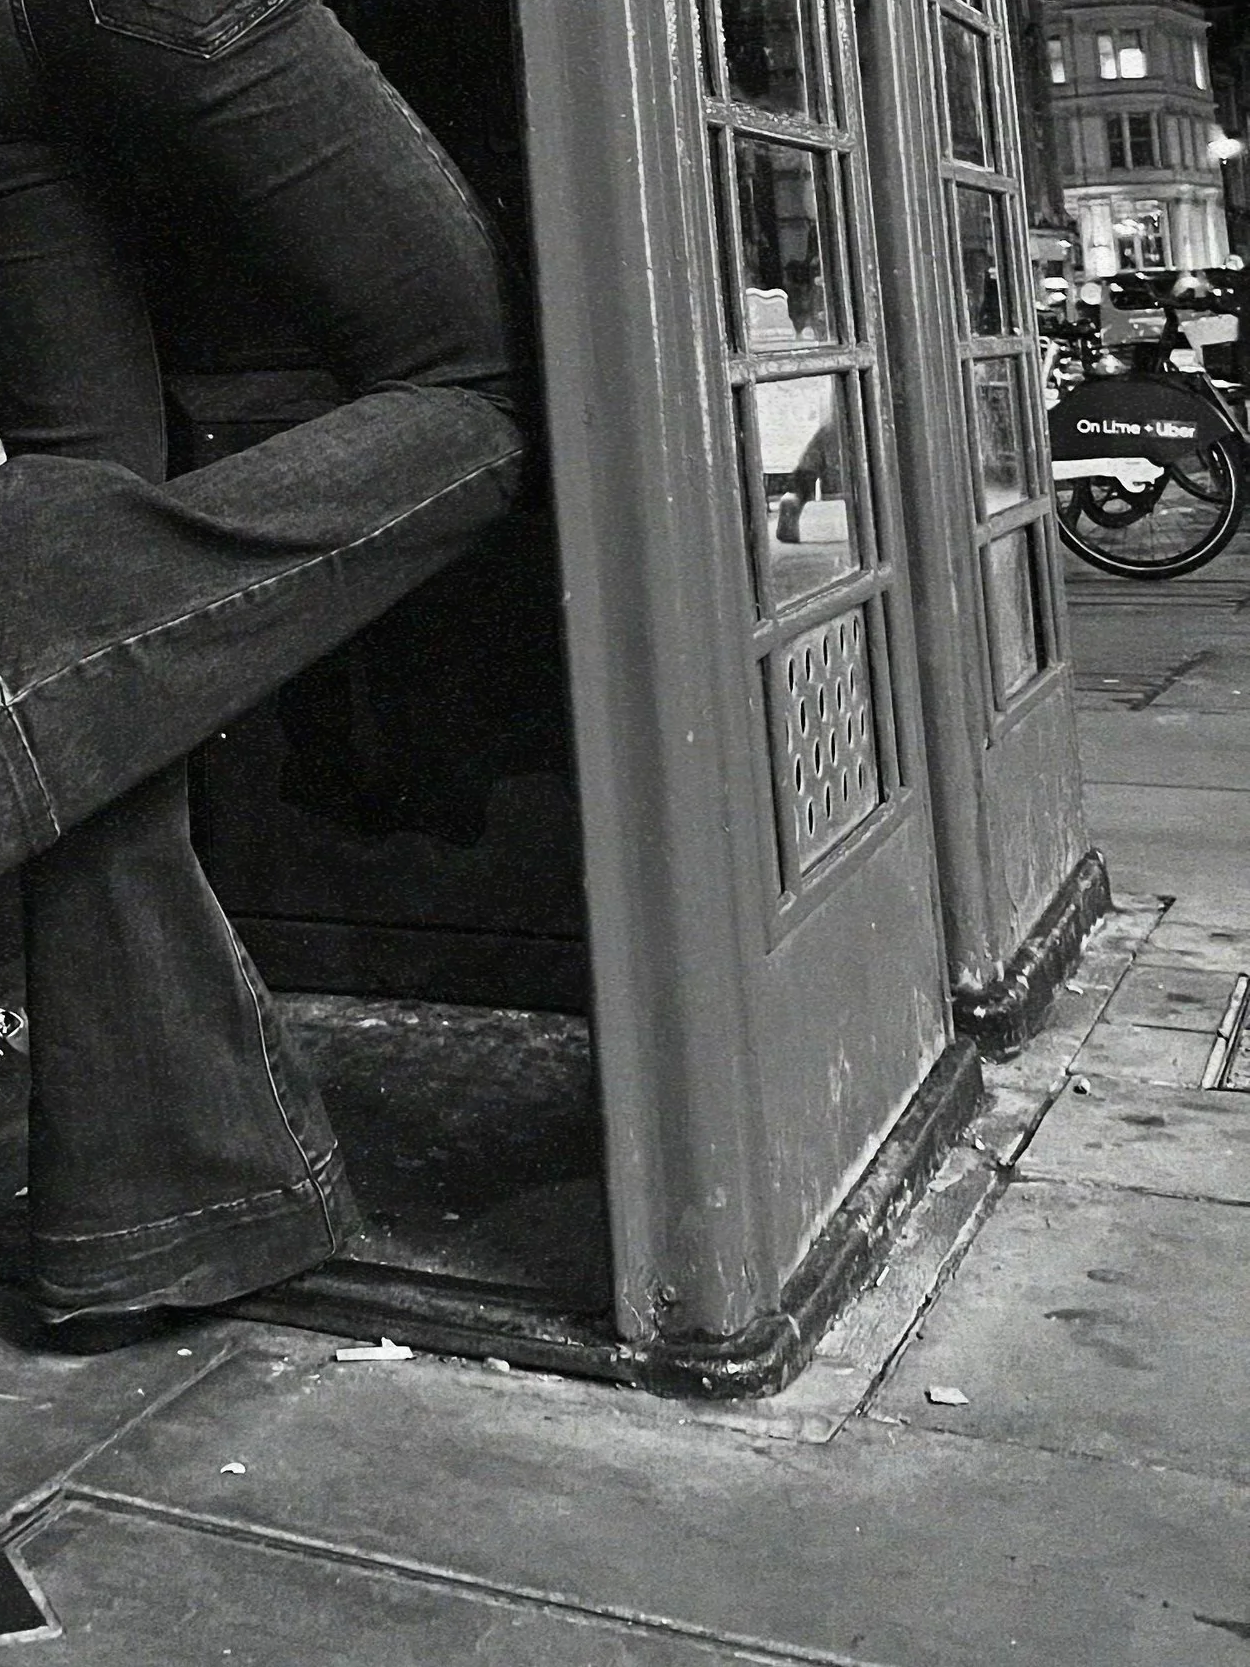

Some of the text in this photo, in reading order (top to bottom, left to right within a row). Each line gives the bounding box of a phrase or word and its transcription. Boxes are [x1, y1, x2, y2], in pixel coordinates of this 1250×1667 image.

[1076, 419, 1101, 434] On
[1102, 419, 1141, 435] Lime
[1155, 421, 1196, 439] Uber
